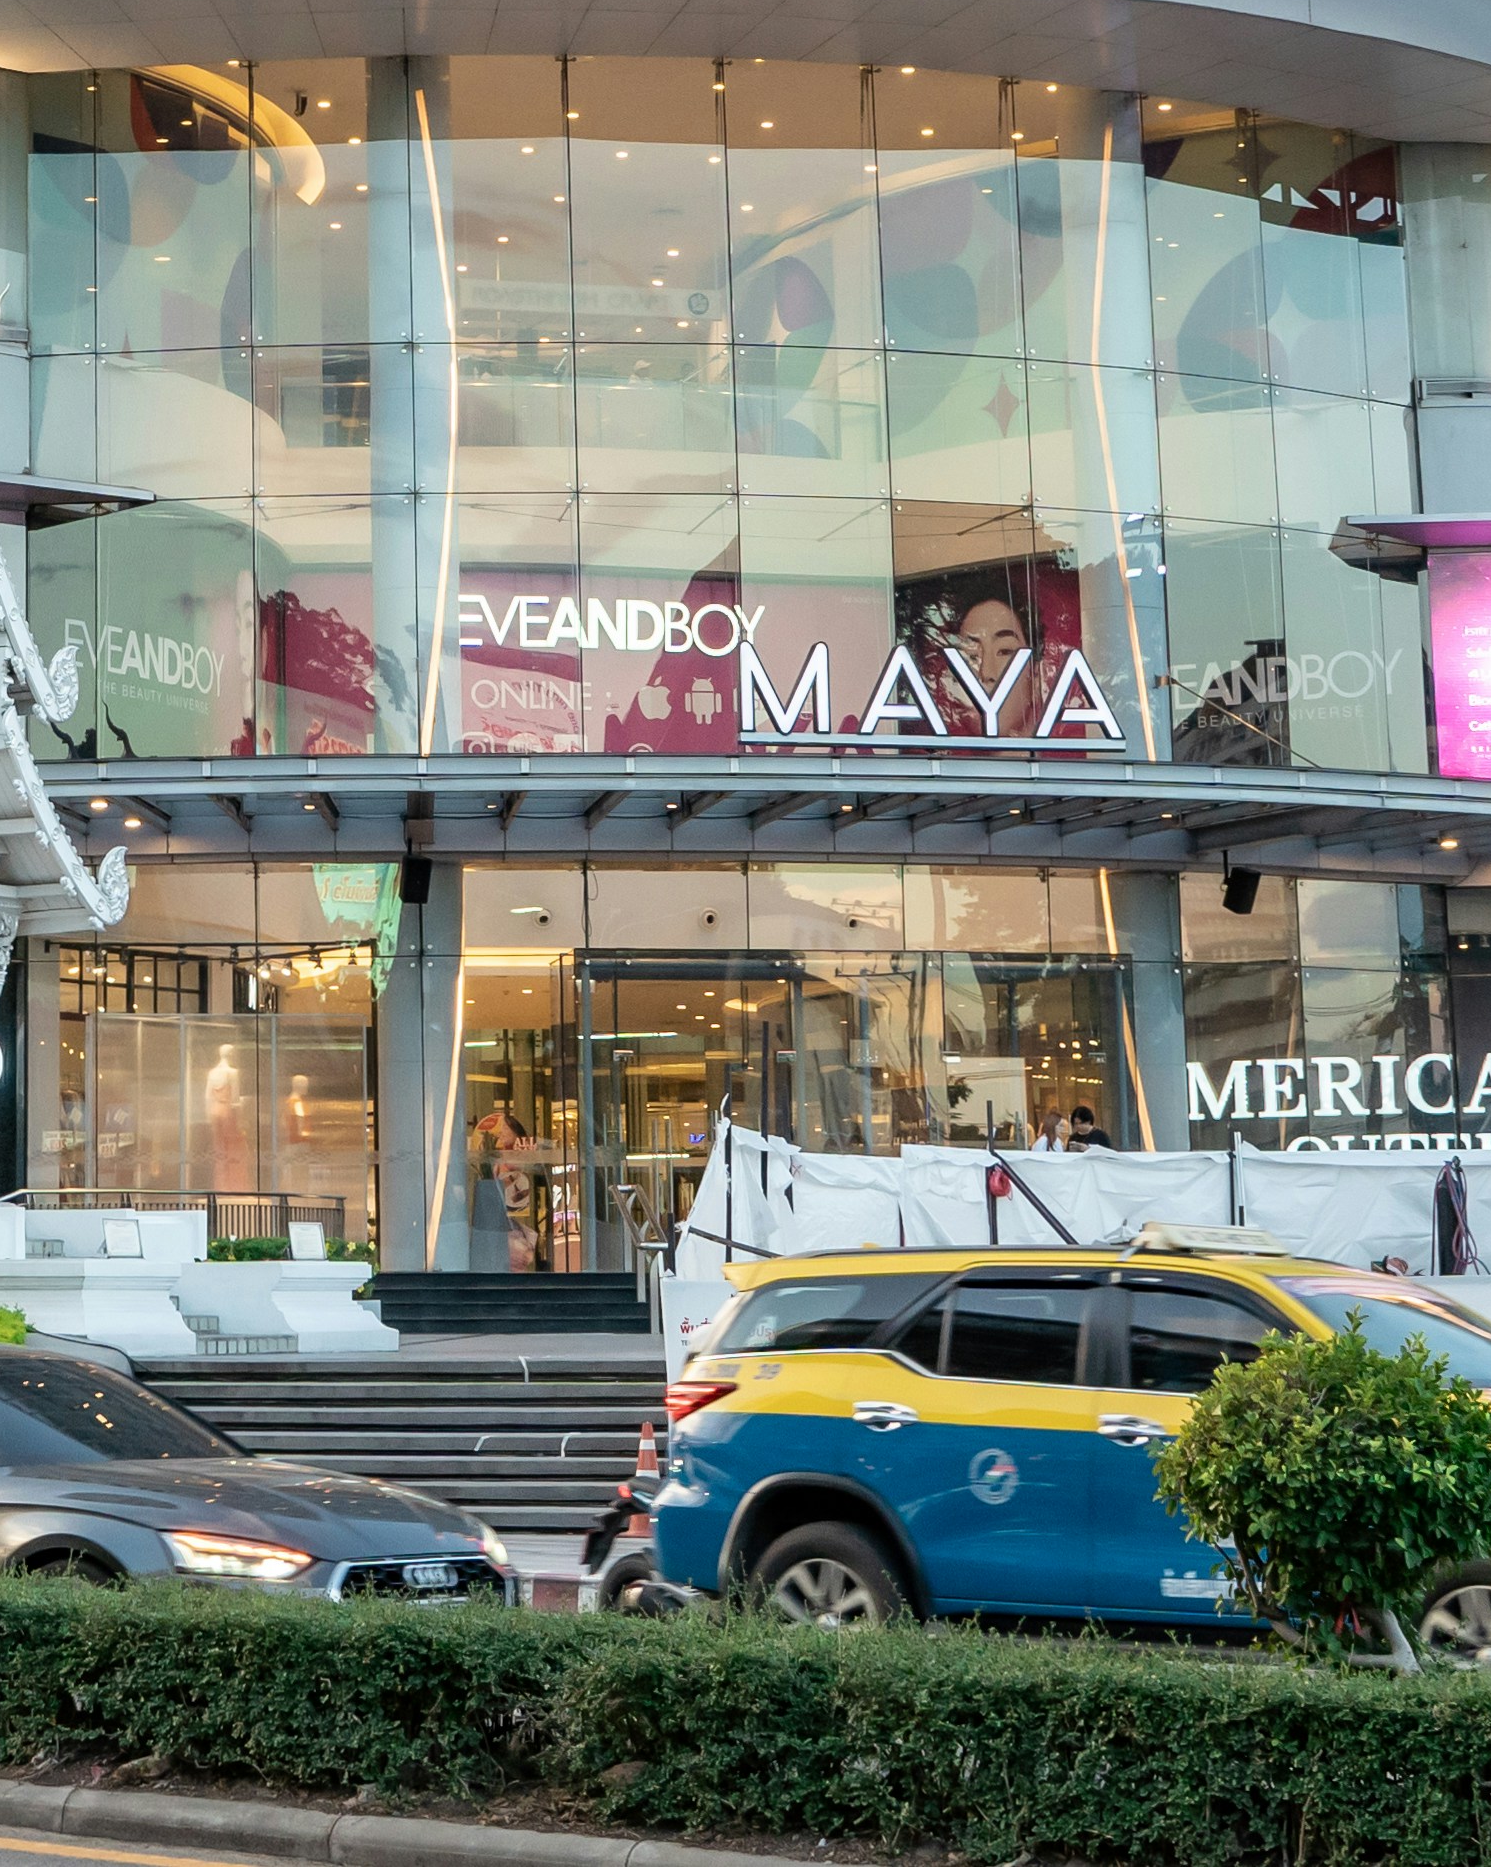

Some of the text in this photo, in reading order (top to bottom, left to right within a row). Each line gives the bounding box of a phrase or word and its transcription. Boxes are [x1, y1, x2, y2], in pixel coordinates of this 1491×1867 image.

[458, 594, 766, 657] EVEANDBOY
[64, 618, 225, 697] EVEANDBOY
[121, 684, 163, 702] BEAUTY
[166, 694, 211, 715] UNIVERSE
[470, 679, 592, 711] ONLINE
[738, 640, 1126, 739] MAYA
[1197, 711, 1266, 729] BEAUTY
[1273, 704, 1365, 724] UNIVERSE
